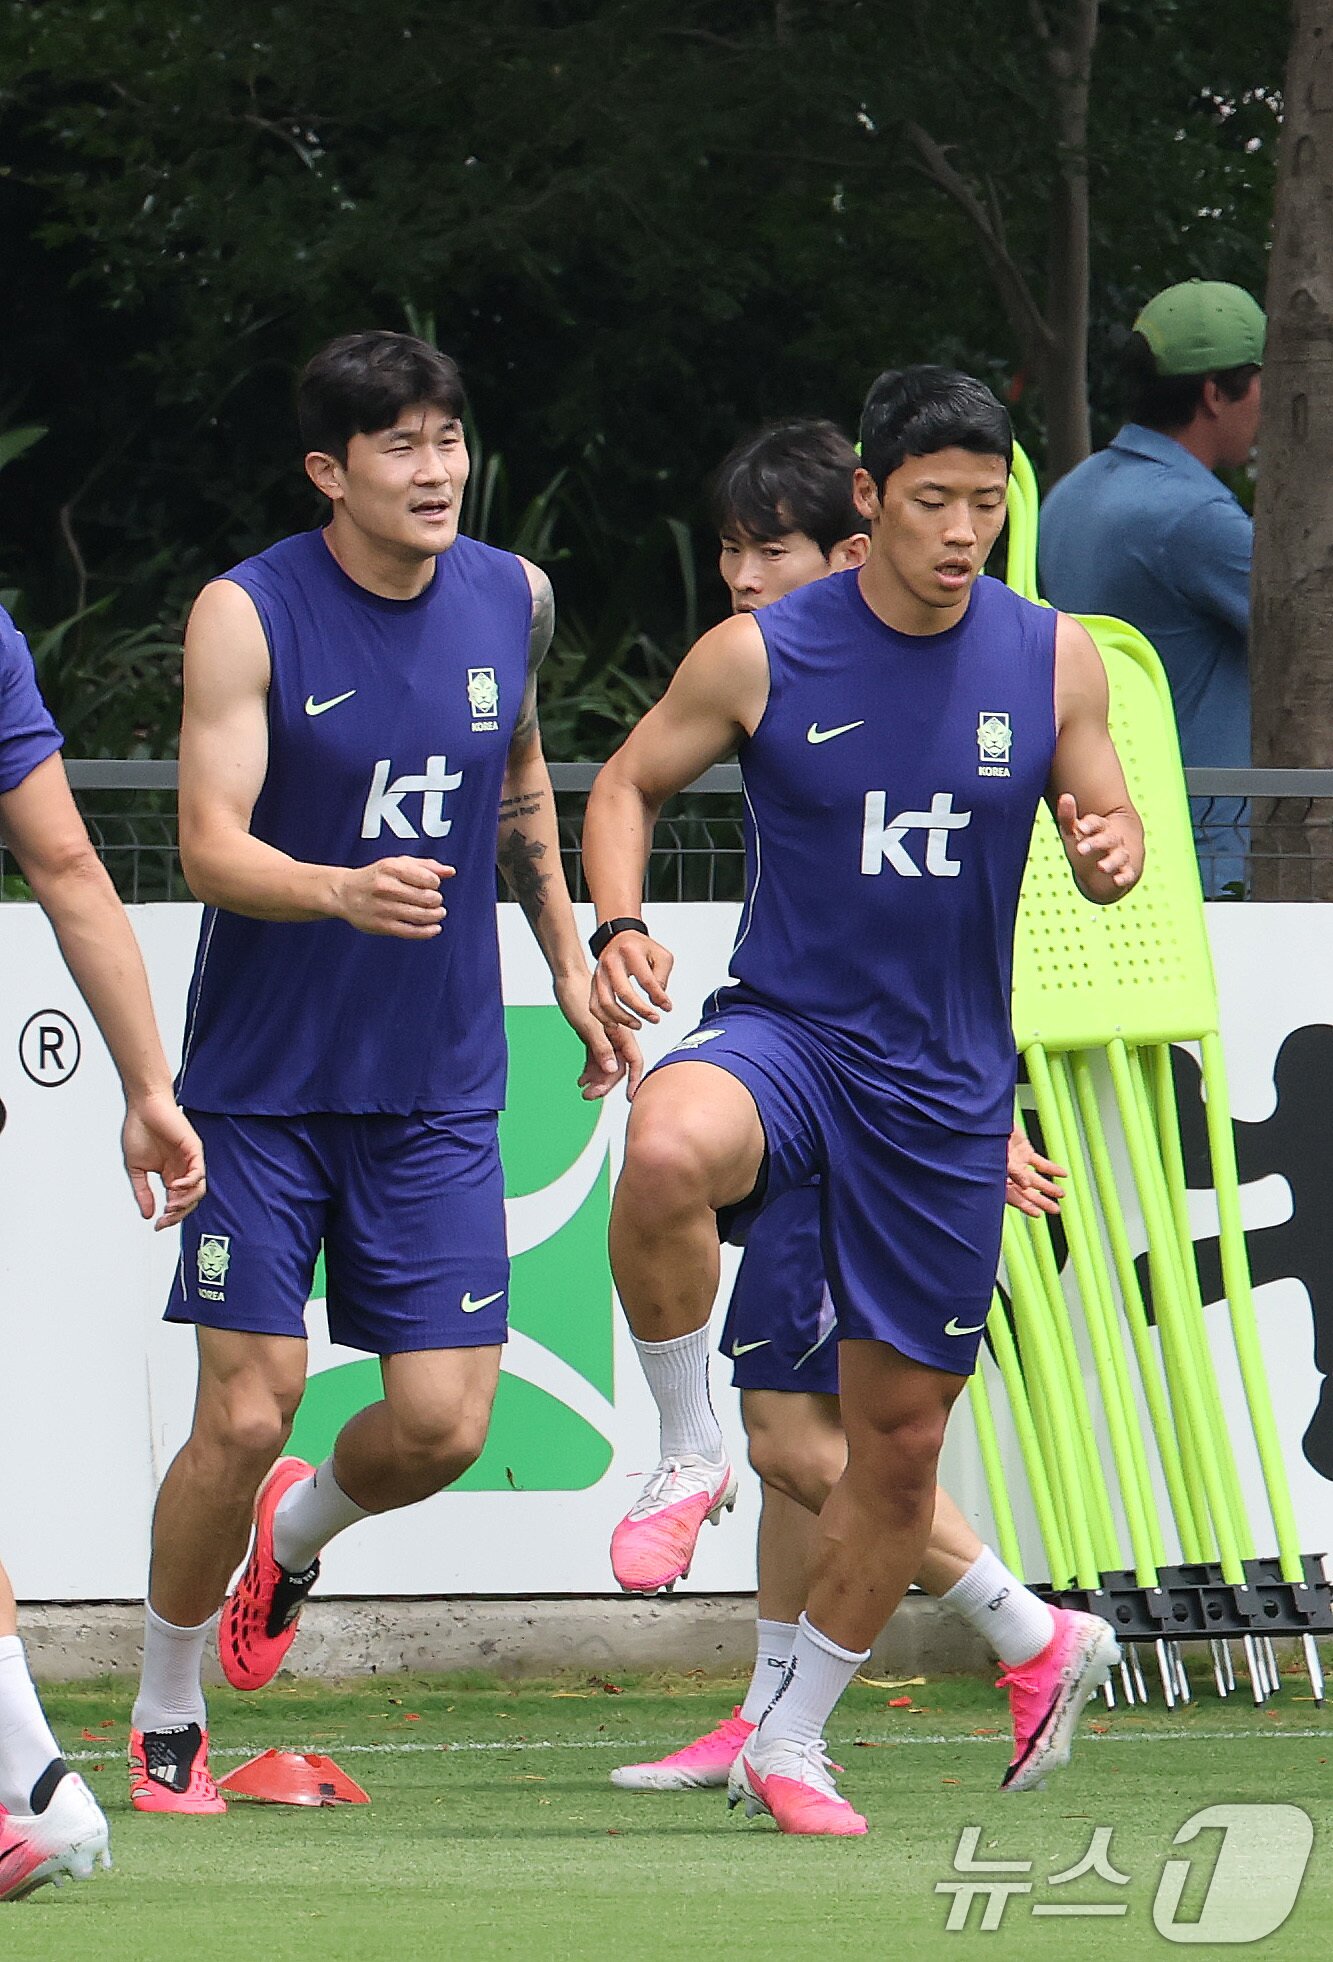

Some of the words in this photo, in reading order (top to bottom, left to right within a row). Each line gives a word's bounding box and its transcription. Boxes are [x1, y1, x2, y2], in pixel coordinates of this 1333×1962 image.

[361, 755, 463, 839] kt
[978, 766, 1011, 777] KOREA
[860, 790, 972, 877] kt
